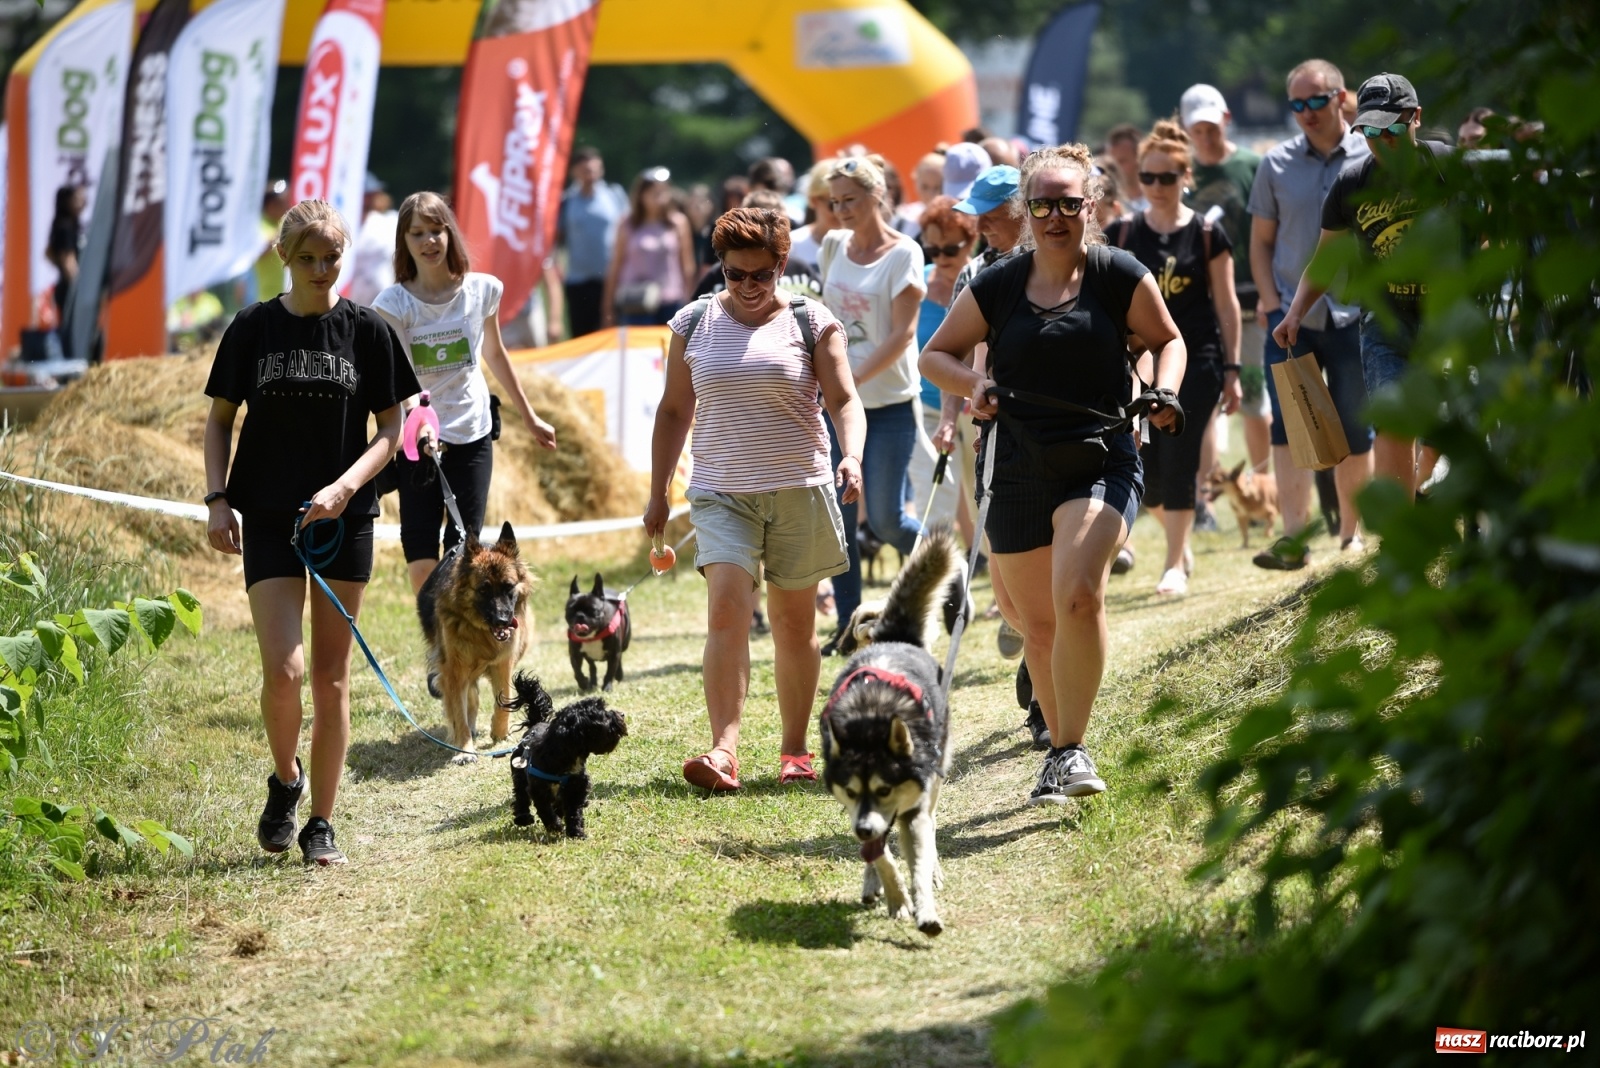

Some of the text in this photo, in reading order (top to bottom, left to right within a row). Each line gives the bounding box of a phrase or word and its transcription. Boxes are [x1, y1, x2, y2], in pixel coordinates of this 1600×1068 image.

[294, 71, 341, 201] OLUX
[188, 50, 237, 256] TropiDog
[1387, 281, 1417, 295] WEST
[413, 328, 463, 342] DOGTREKKING
[436, 347, 447, 361] 6
[257, 349, 358, 396] LOS ANGELES
